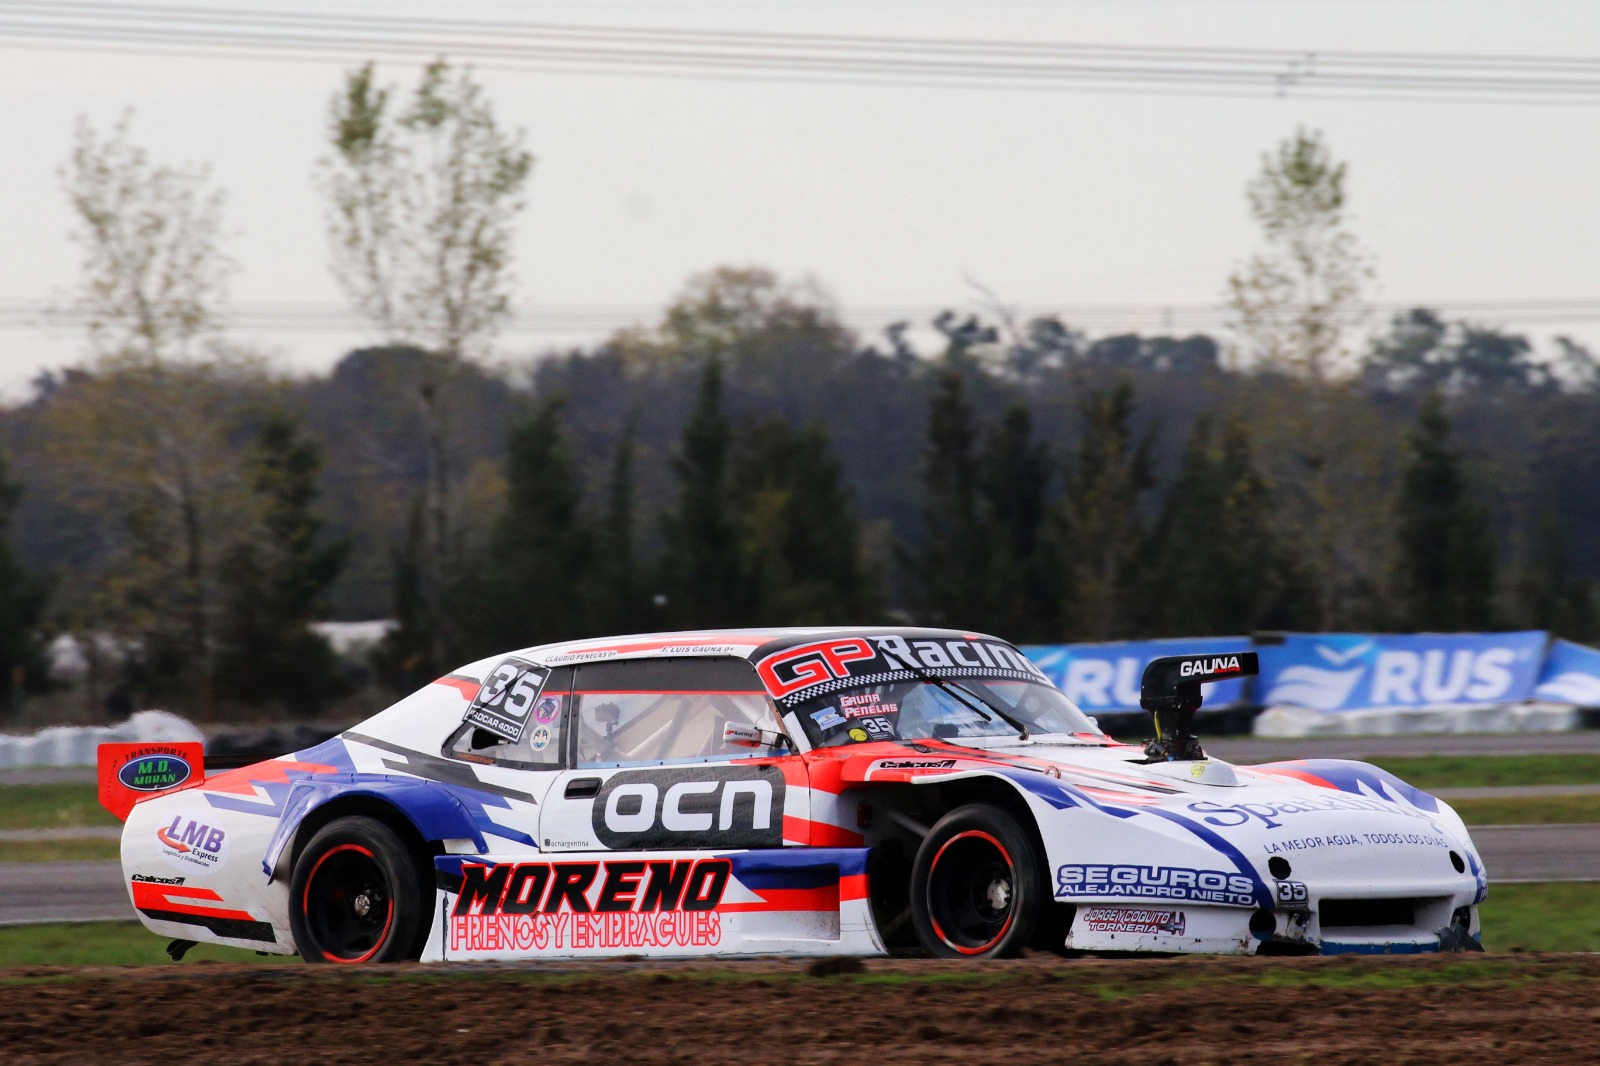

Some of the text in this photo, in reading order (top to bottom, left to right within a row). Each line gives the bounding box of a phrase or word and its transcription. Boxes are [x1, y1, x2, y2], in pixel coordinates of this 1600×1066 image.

[545, 654, 575, 663] CLAUDIO
[576, 651, 607, 660] PENELAS
[1180, 656, 1240, 677] GAUNA
[756, 637, 877, 700] GP
[1370, 649, 1515, 702] RUS
[479, 664, 543, 718] 35
[499, 722, 520, 737] 4000
[861, 716, 890, 733] 35
[125, 746, 188, 763] TRANSPORTE
[138, 760, 172, 774] M.D.
[134, 773, 176, 785] MORAN
[605, 779, 773, 833] ocn
[167, 815, 225, 853] LMB
[1263, 832, 1449, 854] LA MEJOR AGUA, TODOS LOS DÍAS
[191, 847, 219, 863] Express
[452, 857, 733, 917] MORENO
[1058, 866, 1254, 895] SEGUROS
[1058, 884, 1253, 905] ALEJANDRO NIETO
[1277, 882, 1307, 901] 35
[570, 910, 722, 949] EMBRAGUES
[1089, 921, 1159, 934] TORNERIA
